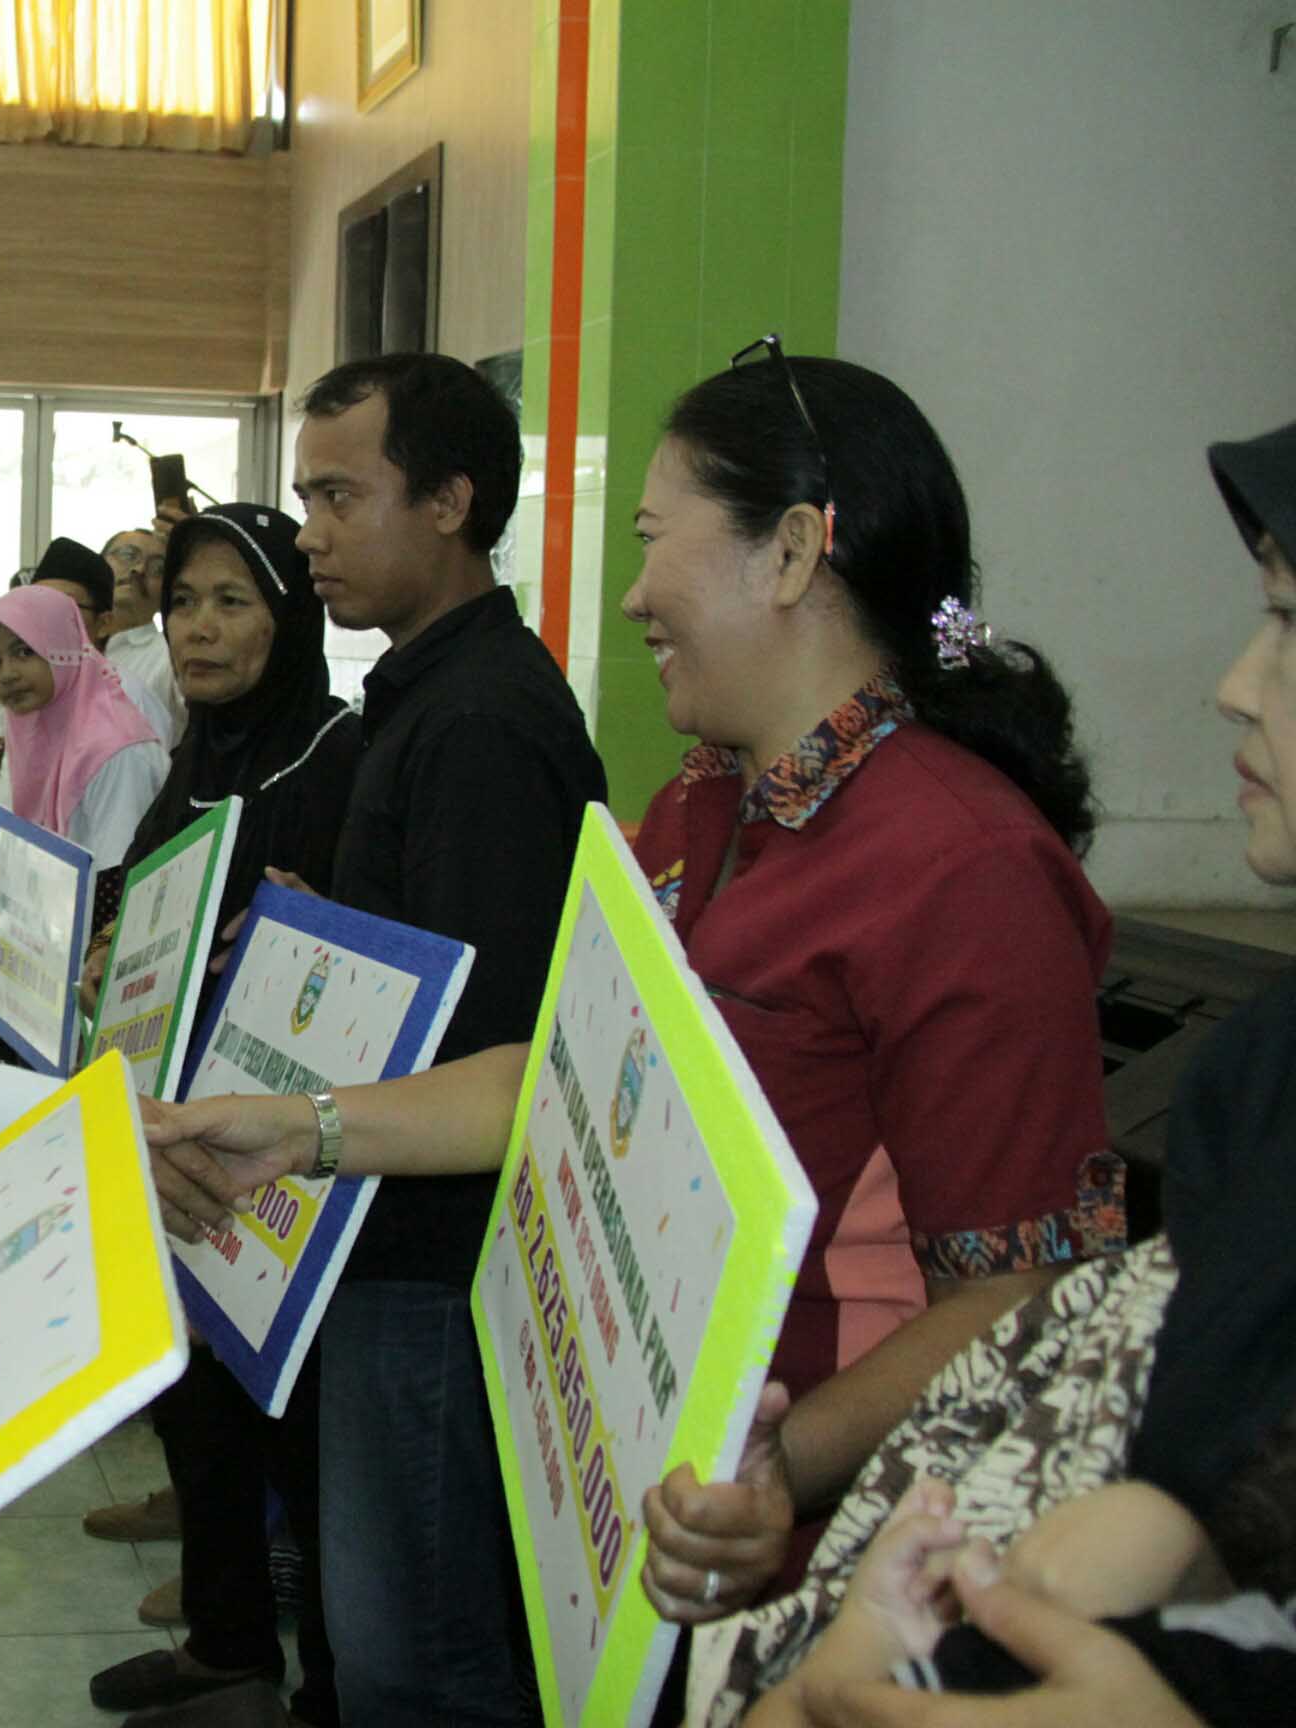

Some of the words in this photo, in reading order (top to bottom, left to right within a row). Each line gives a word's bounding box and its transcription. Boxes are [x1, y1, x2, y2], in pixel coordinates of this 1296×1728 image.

[550, 1021, 590, 1147] BANTUAN
[582, 1125, 649, 1343] OPERASIONAL
[642, 1313, 675, 1420] PKH
